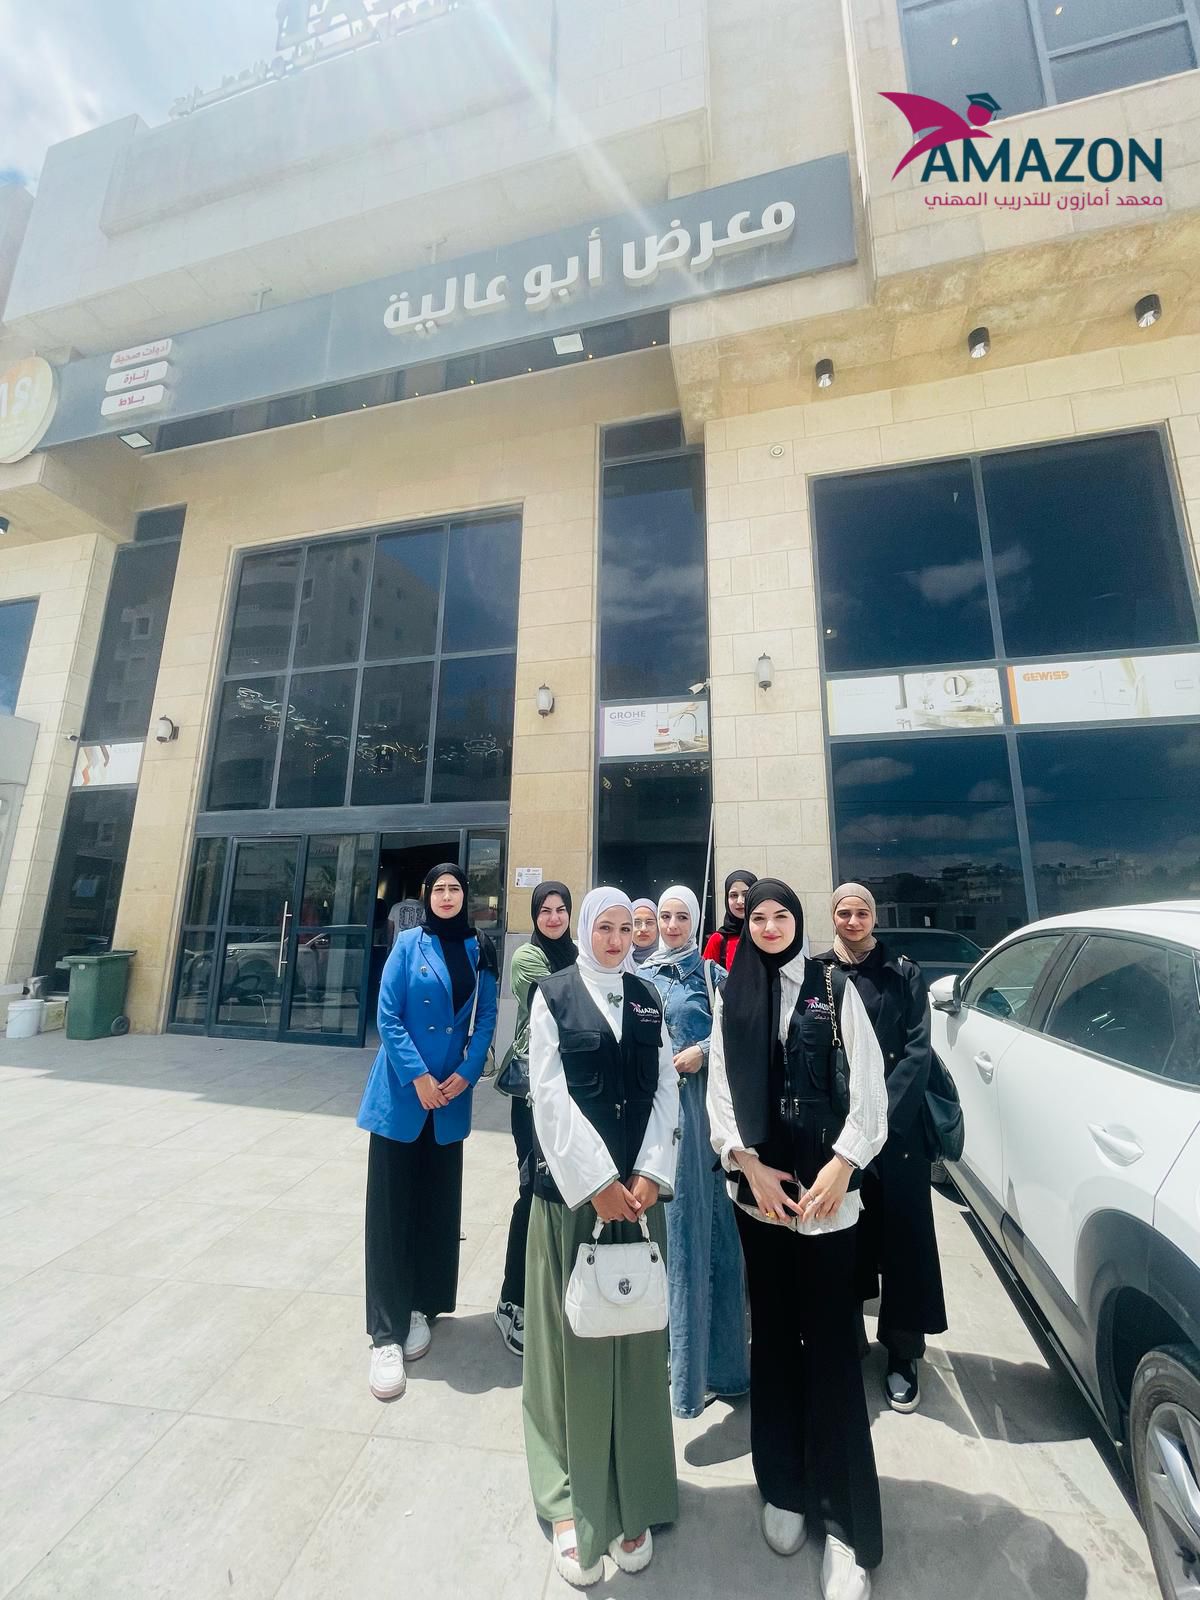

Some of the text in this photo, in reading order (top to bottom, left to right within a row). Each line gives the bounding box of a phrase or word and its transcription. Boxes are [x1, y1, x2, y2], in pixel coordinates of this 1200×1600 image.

[383, 201, 796, 334] معرض أبو عالية
[114, 351, 142, 364] صحية
[609, 710, 647, 720] GROHE
